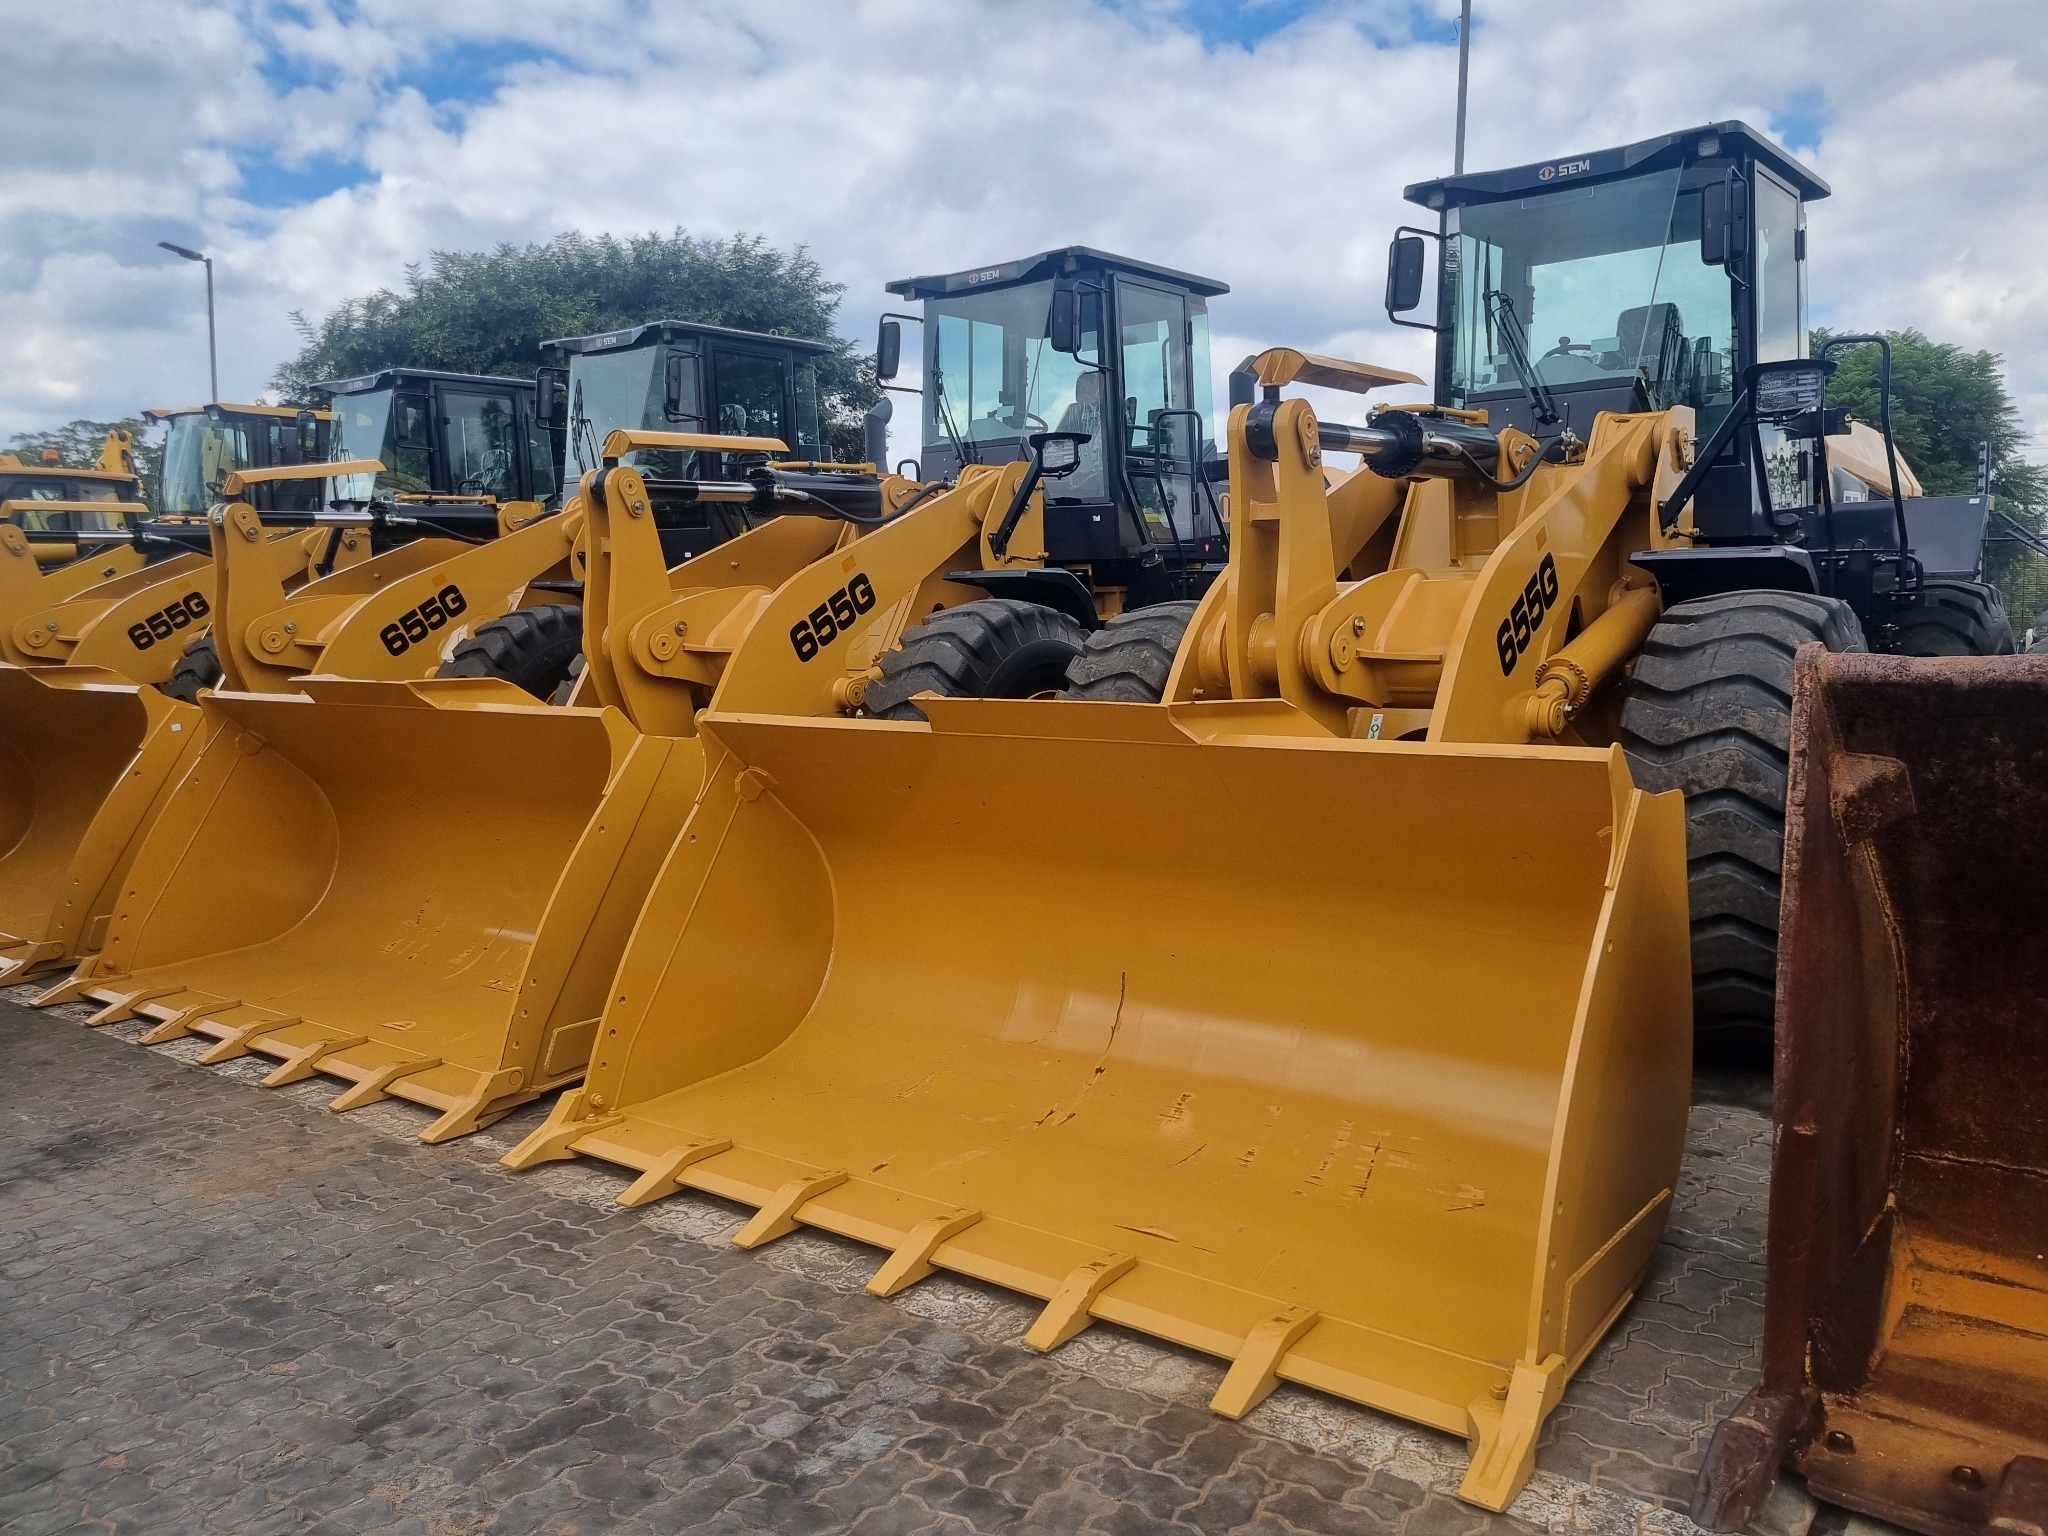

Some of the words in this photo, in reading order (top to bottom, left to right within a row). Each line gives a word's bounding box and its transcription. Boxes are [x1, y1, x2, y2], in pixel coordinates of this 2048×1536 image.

[1558, 159, 1590, 177] SEM
[980, 269, 1000, 282] SEM
[603, 336, 617, 346] SEM
[127, 591, 211, 651] 655G
[379, 584, 468, 657] 655G
[789, 572, 877, 664] 655G
[1496, 551, 1559, 678] 655G
